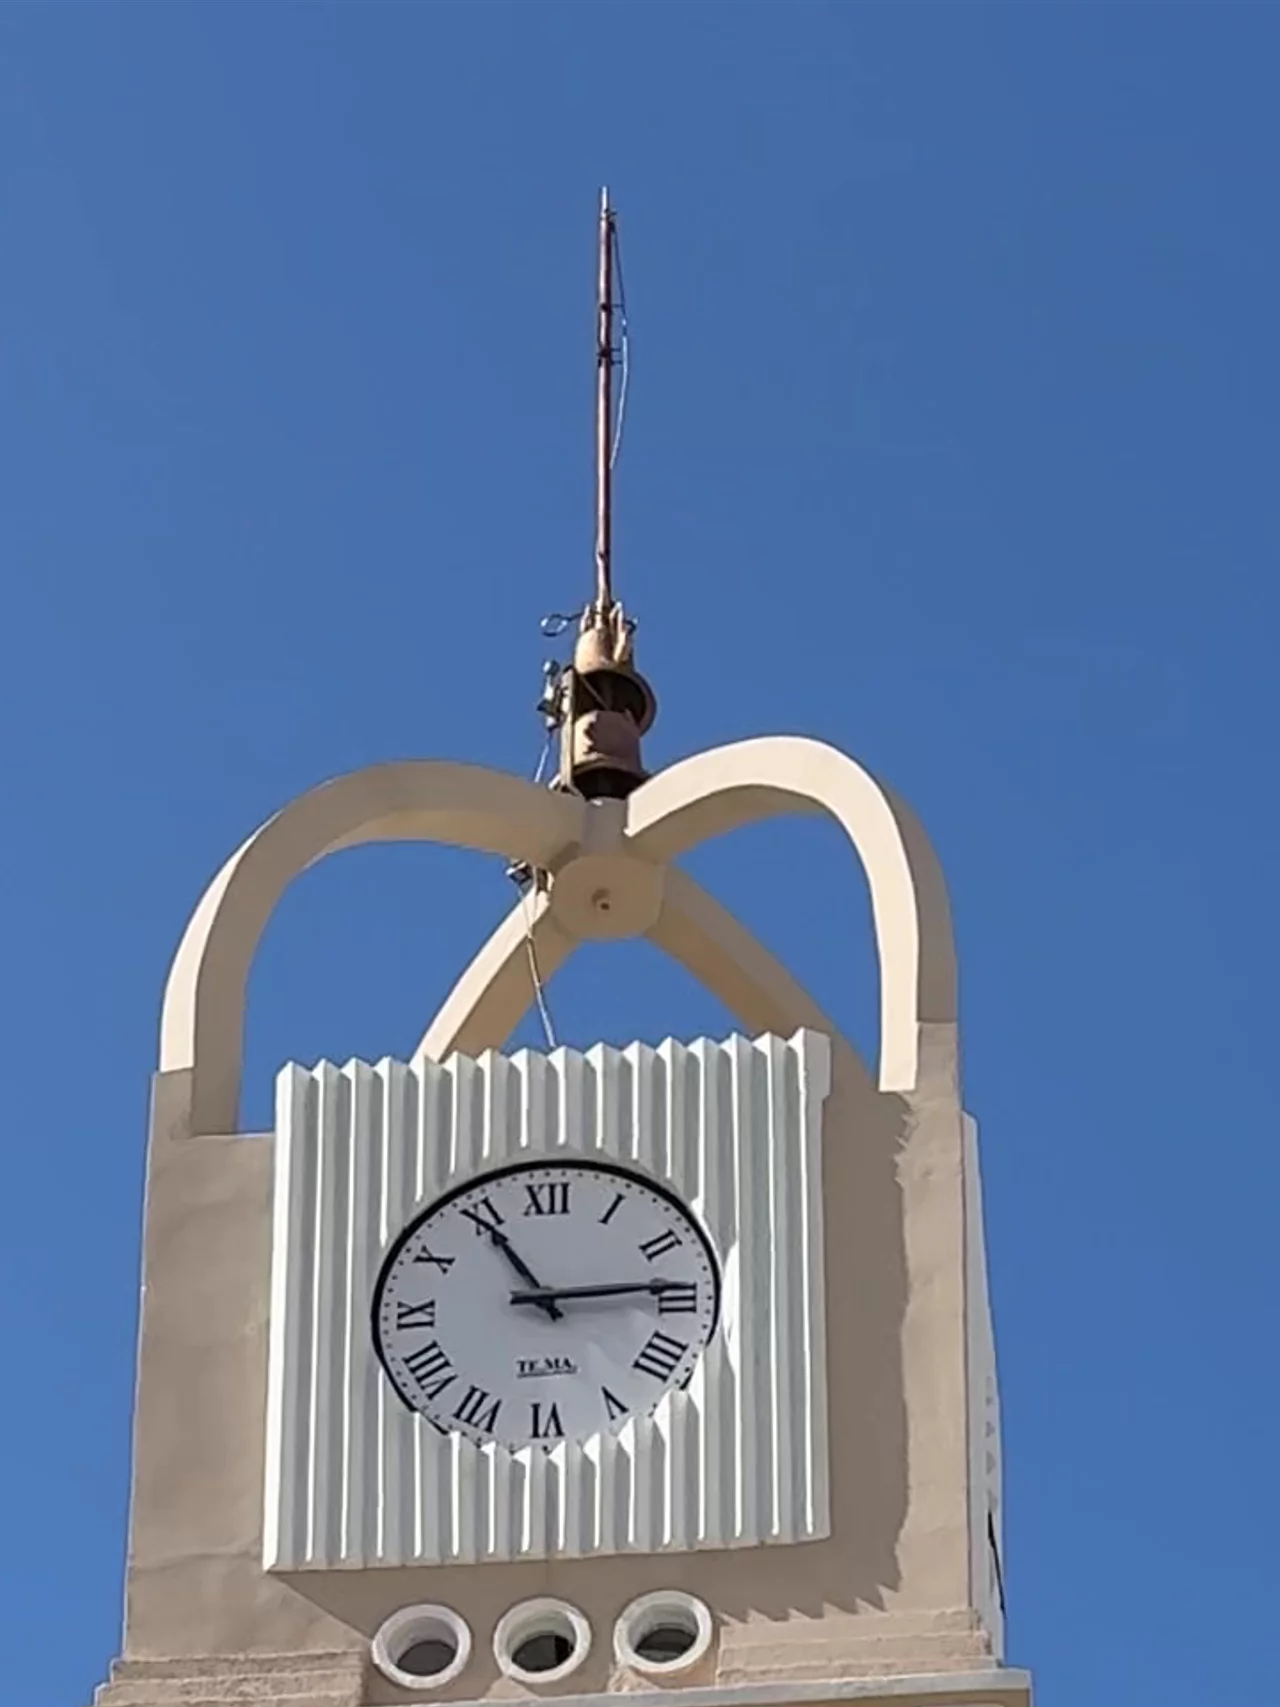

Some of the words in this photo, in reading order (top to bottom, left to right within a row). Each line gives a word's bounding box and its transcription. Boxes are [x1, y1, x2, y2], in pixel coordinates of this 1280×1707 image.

[524, 1183, 570, 1216] XII
[598, 1193, 625, 1224] I
[460, 1196, 508, 1242] XI
[413, 1245, 455, 1275] X
[639, 1229, 682, 1262] II
[656, 1282, 697, 1314] III
[397, 1300, 435, 1330] IX
[402, 1340, 458, 1400] VIII
[633, 1331, 689, 1383] IIII
[452, 1384, 502, 1434] VII
[601, 1386, 629, 1420] V
[531, 1402, 566, 1438] VI
